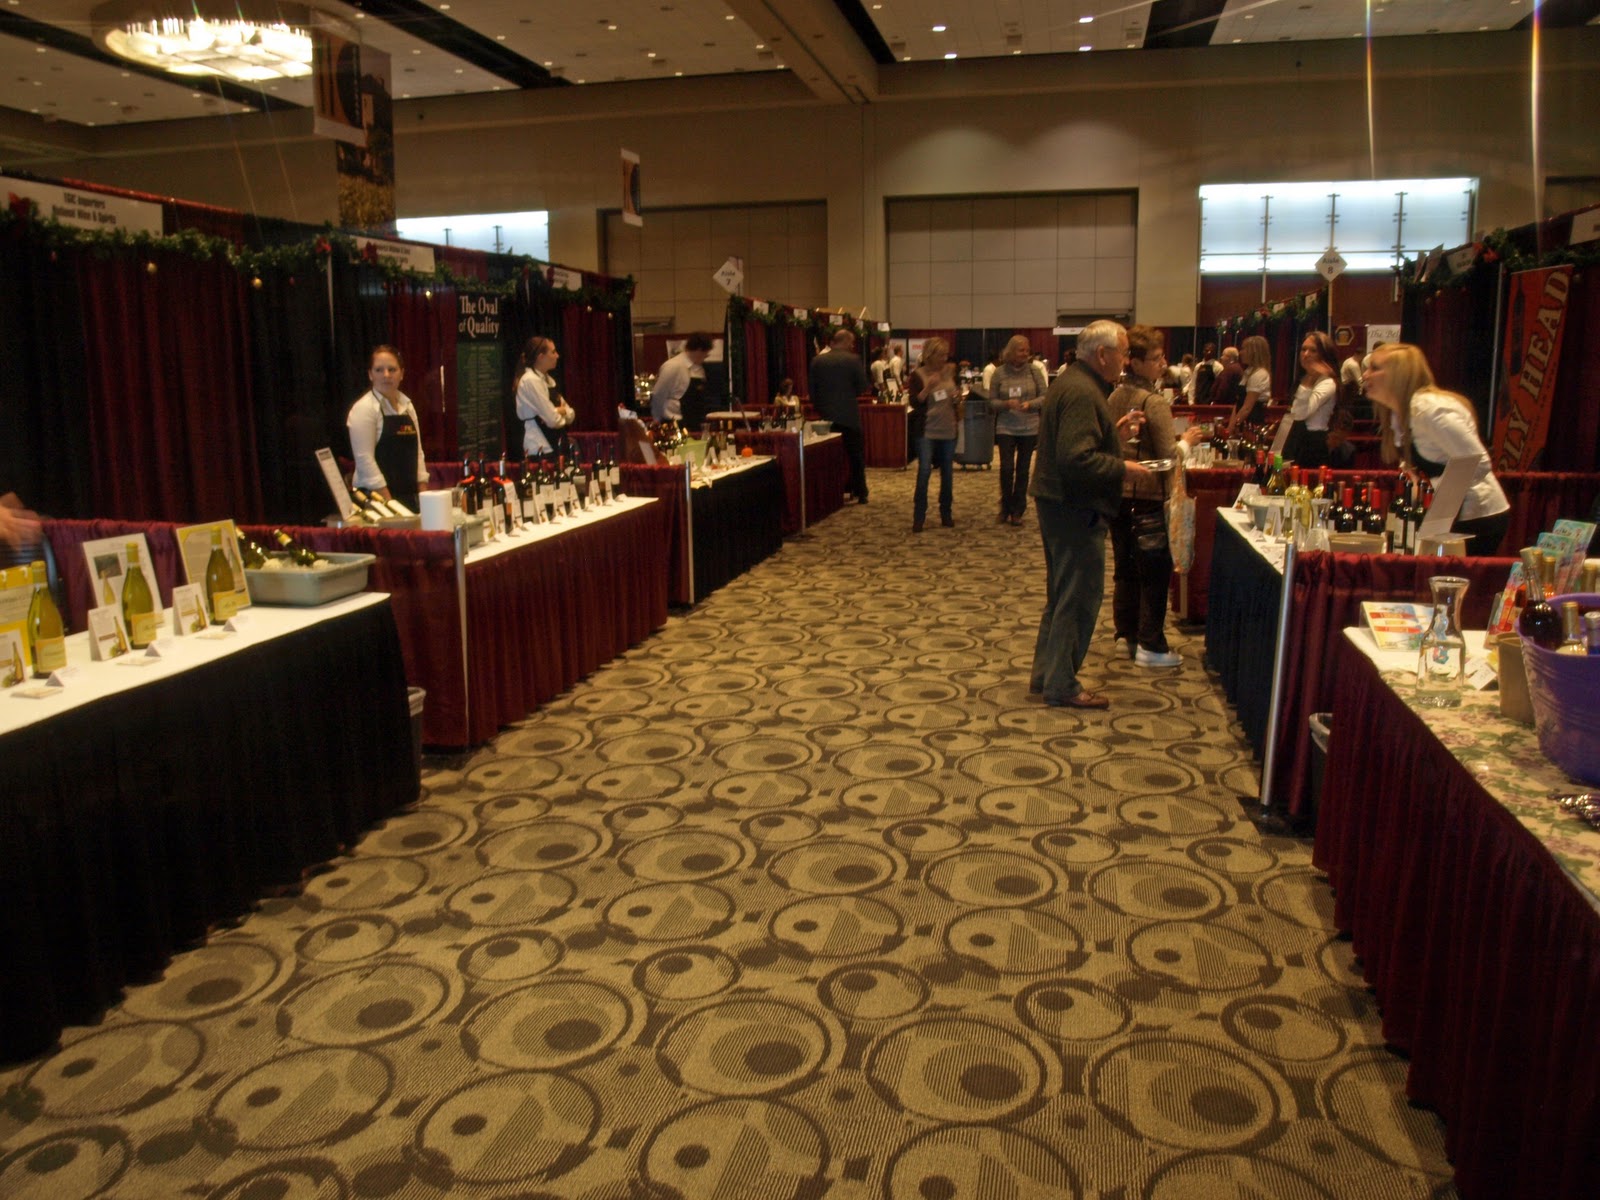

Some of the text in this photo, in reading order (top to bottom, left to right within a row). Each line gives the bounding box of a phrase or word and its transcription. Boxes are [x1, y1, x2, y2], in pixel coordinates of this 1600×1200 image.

[459, 295, 498, 315] The Oval
[458, 316, 500, 339] of Quality
[1520, 270, 1570, 400] HEAD
